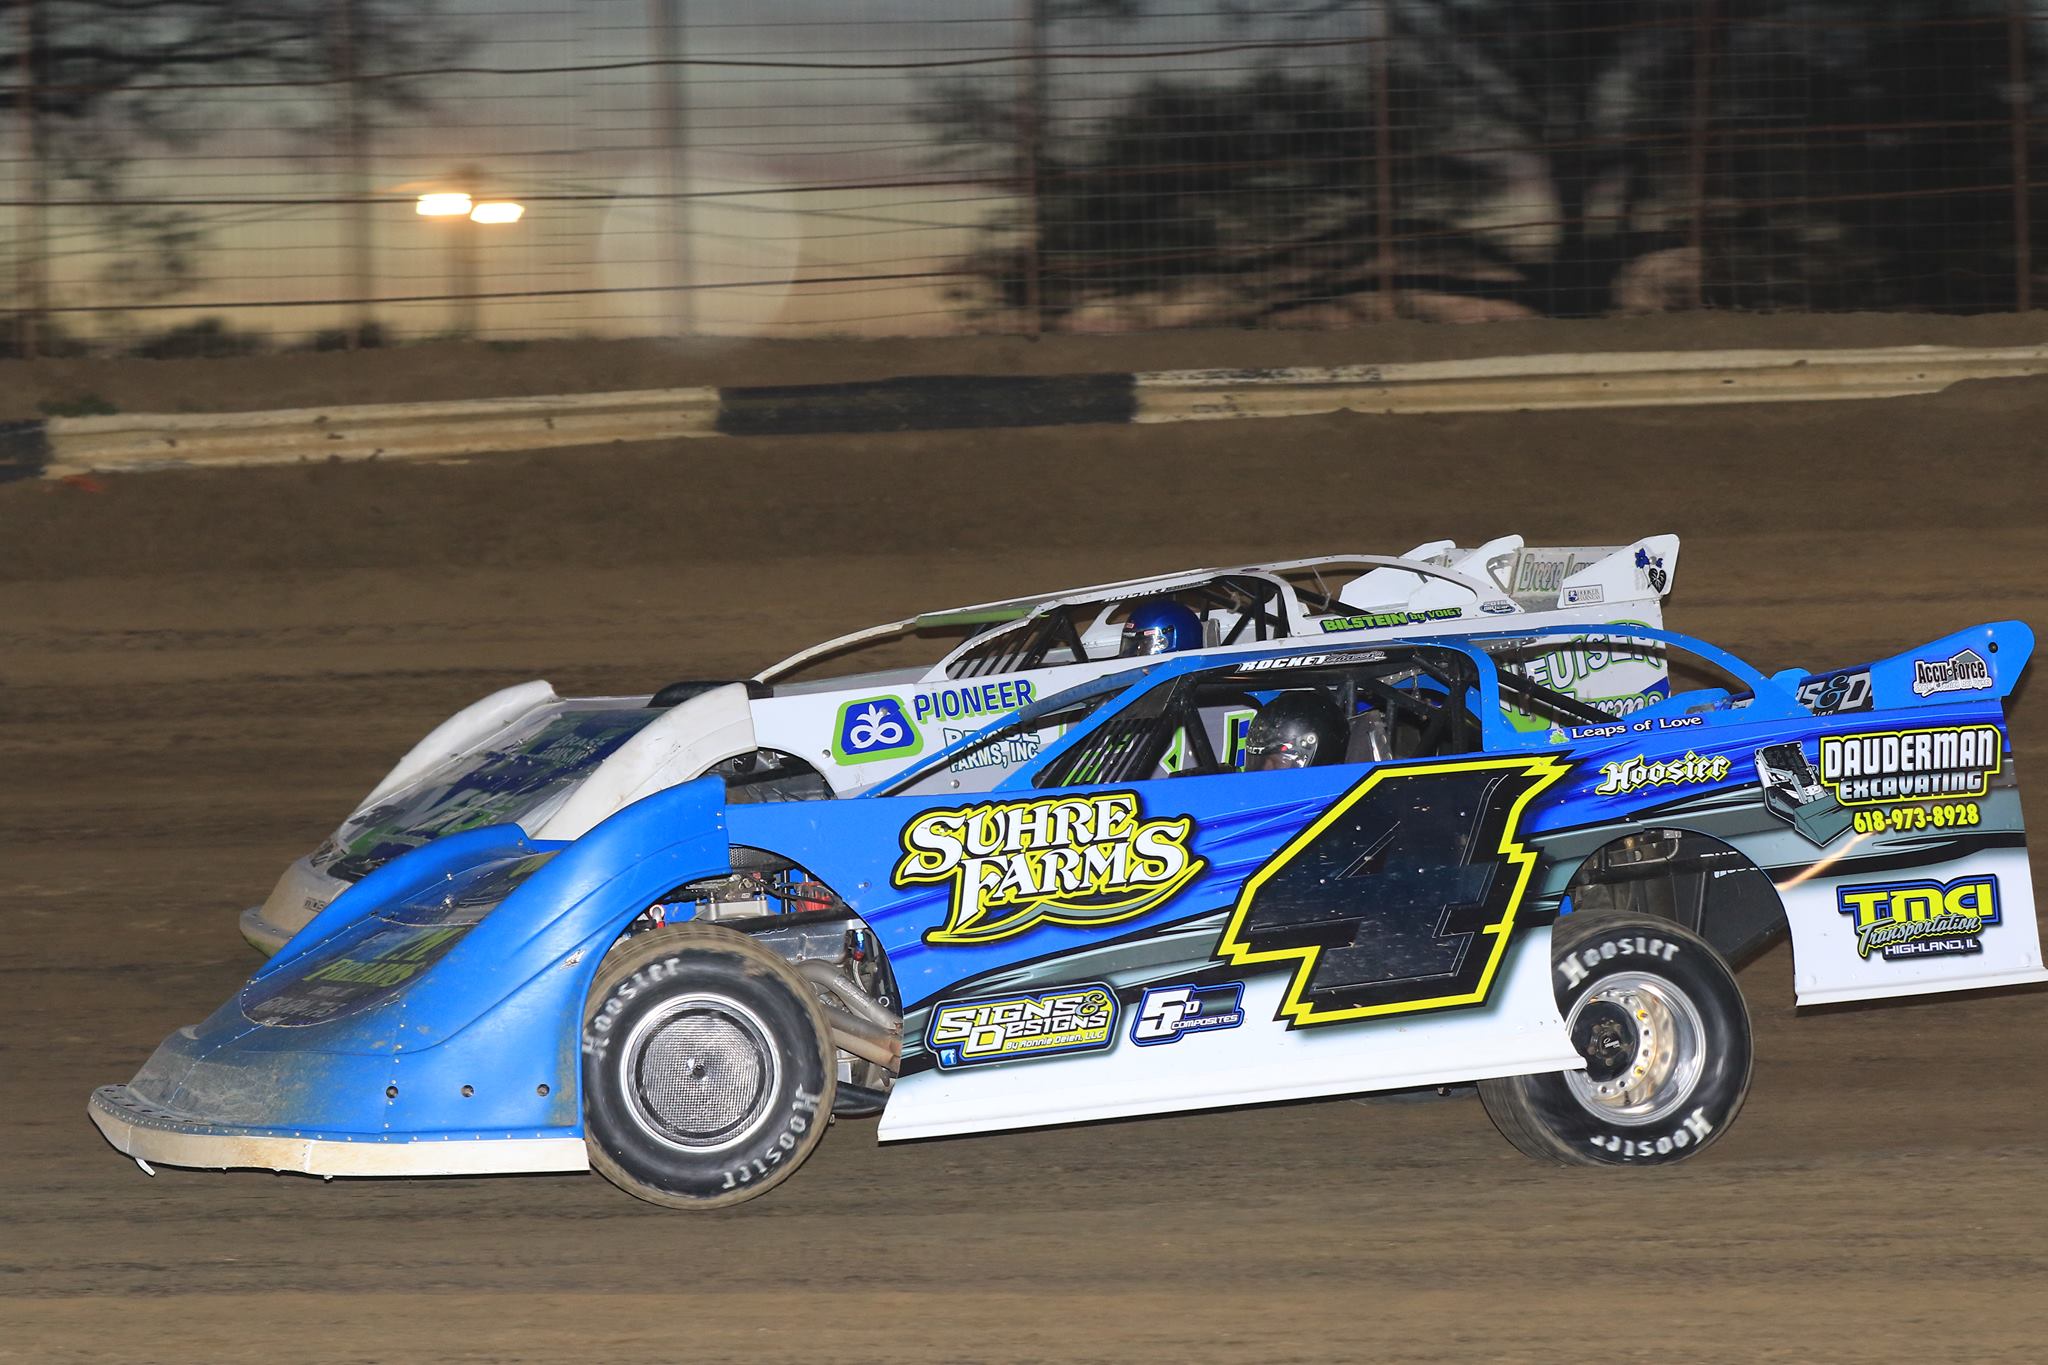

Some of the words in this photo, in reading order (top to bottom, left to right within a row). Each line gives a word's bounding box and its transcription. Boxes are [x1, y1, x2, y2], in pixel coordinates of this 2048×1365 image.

[1322, 612, 1409, 632] BILSTEIN
[1410, 612, 1427, 623] by
[1427, 608, 1463, 620] VOIGT
[1238, 655, 1329, 672] ROCKET
[914, 679, 1035, 721] PIONEER
[1572, 723, 1627, 739] Leaps
[1633, 720, 1653, 732] of
[1660, 716, 1703, 729] Love
[1597, 752, 1730, 793] Hoosier
[1825, 729, 1995, 778] DAUDERMAN
[1840, 771, 1982, 800] EXCAVATING
[904, 797, 1135, 876] SUHRE
[1853, 804, 1980, 833] 618-973-8928
[950, 826, 1186, 934] FARMS
[1217, 755, 1573, 1026] 4
[1859, 912, 1980, 957] Transportation
[1885, 941, 1965, 955] HIGHLAND,
[1967, 939, 1978, 948] IL
[937, 996, 1084, 1040] SIGNS
[966, 1009, 1108, 1054] DESIGNS
[1171, 1014, 1239, 1030] COMPOSITES
[1020, 1037, 1053, 1048] Ronnie
[1085, 1030, 1104, 1040] LLC
